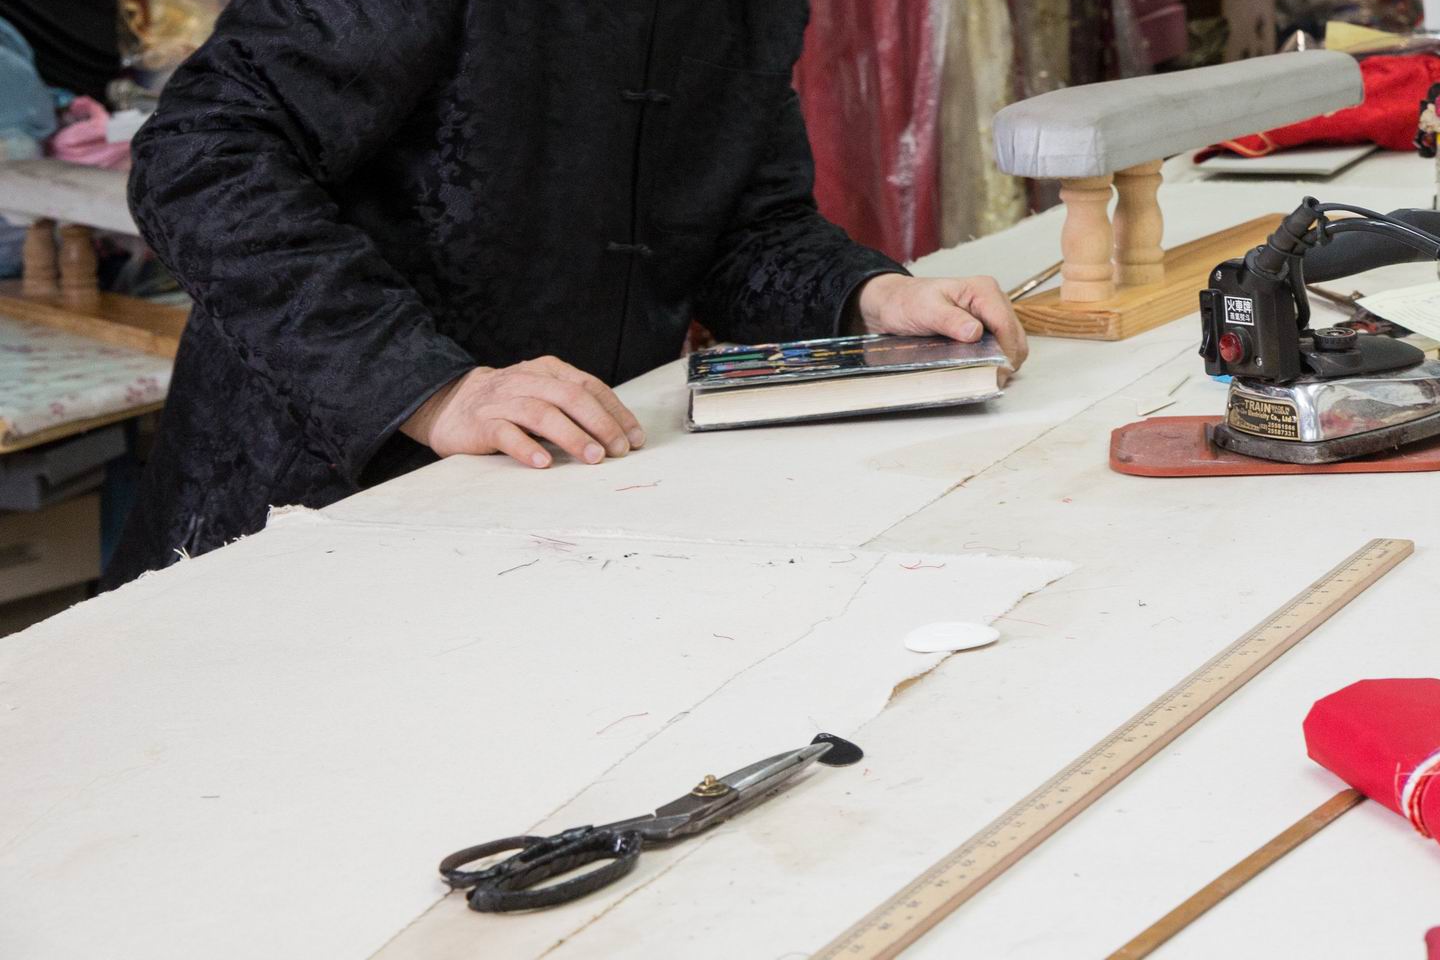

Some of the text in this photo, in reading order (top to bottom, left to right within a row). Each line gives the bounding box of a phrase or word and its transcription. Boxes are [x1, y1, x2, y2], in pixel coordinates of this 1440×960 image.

[1227, 299, 1252, 314] 火車牌
[1244, 400, 1271, 413] TRAIN
